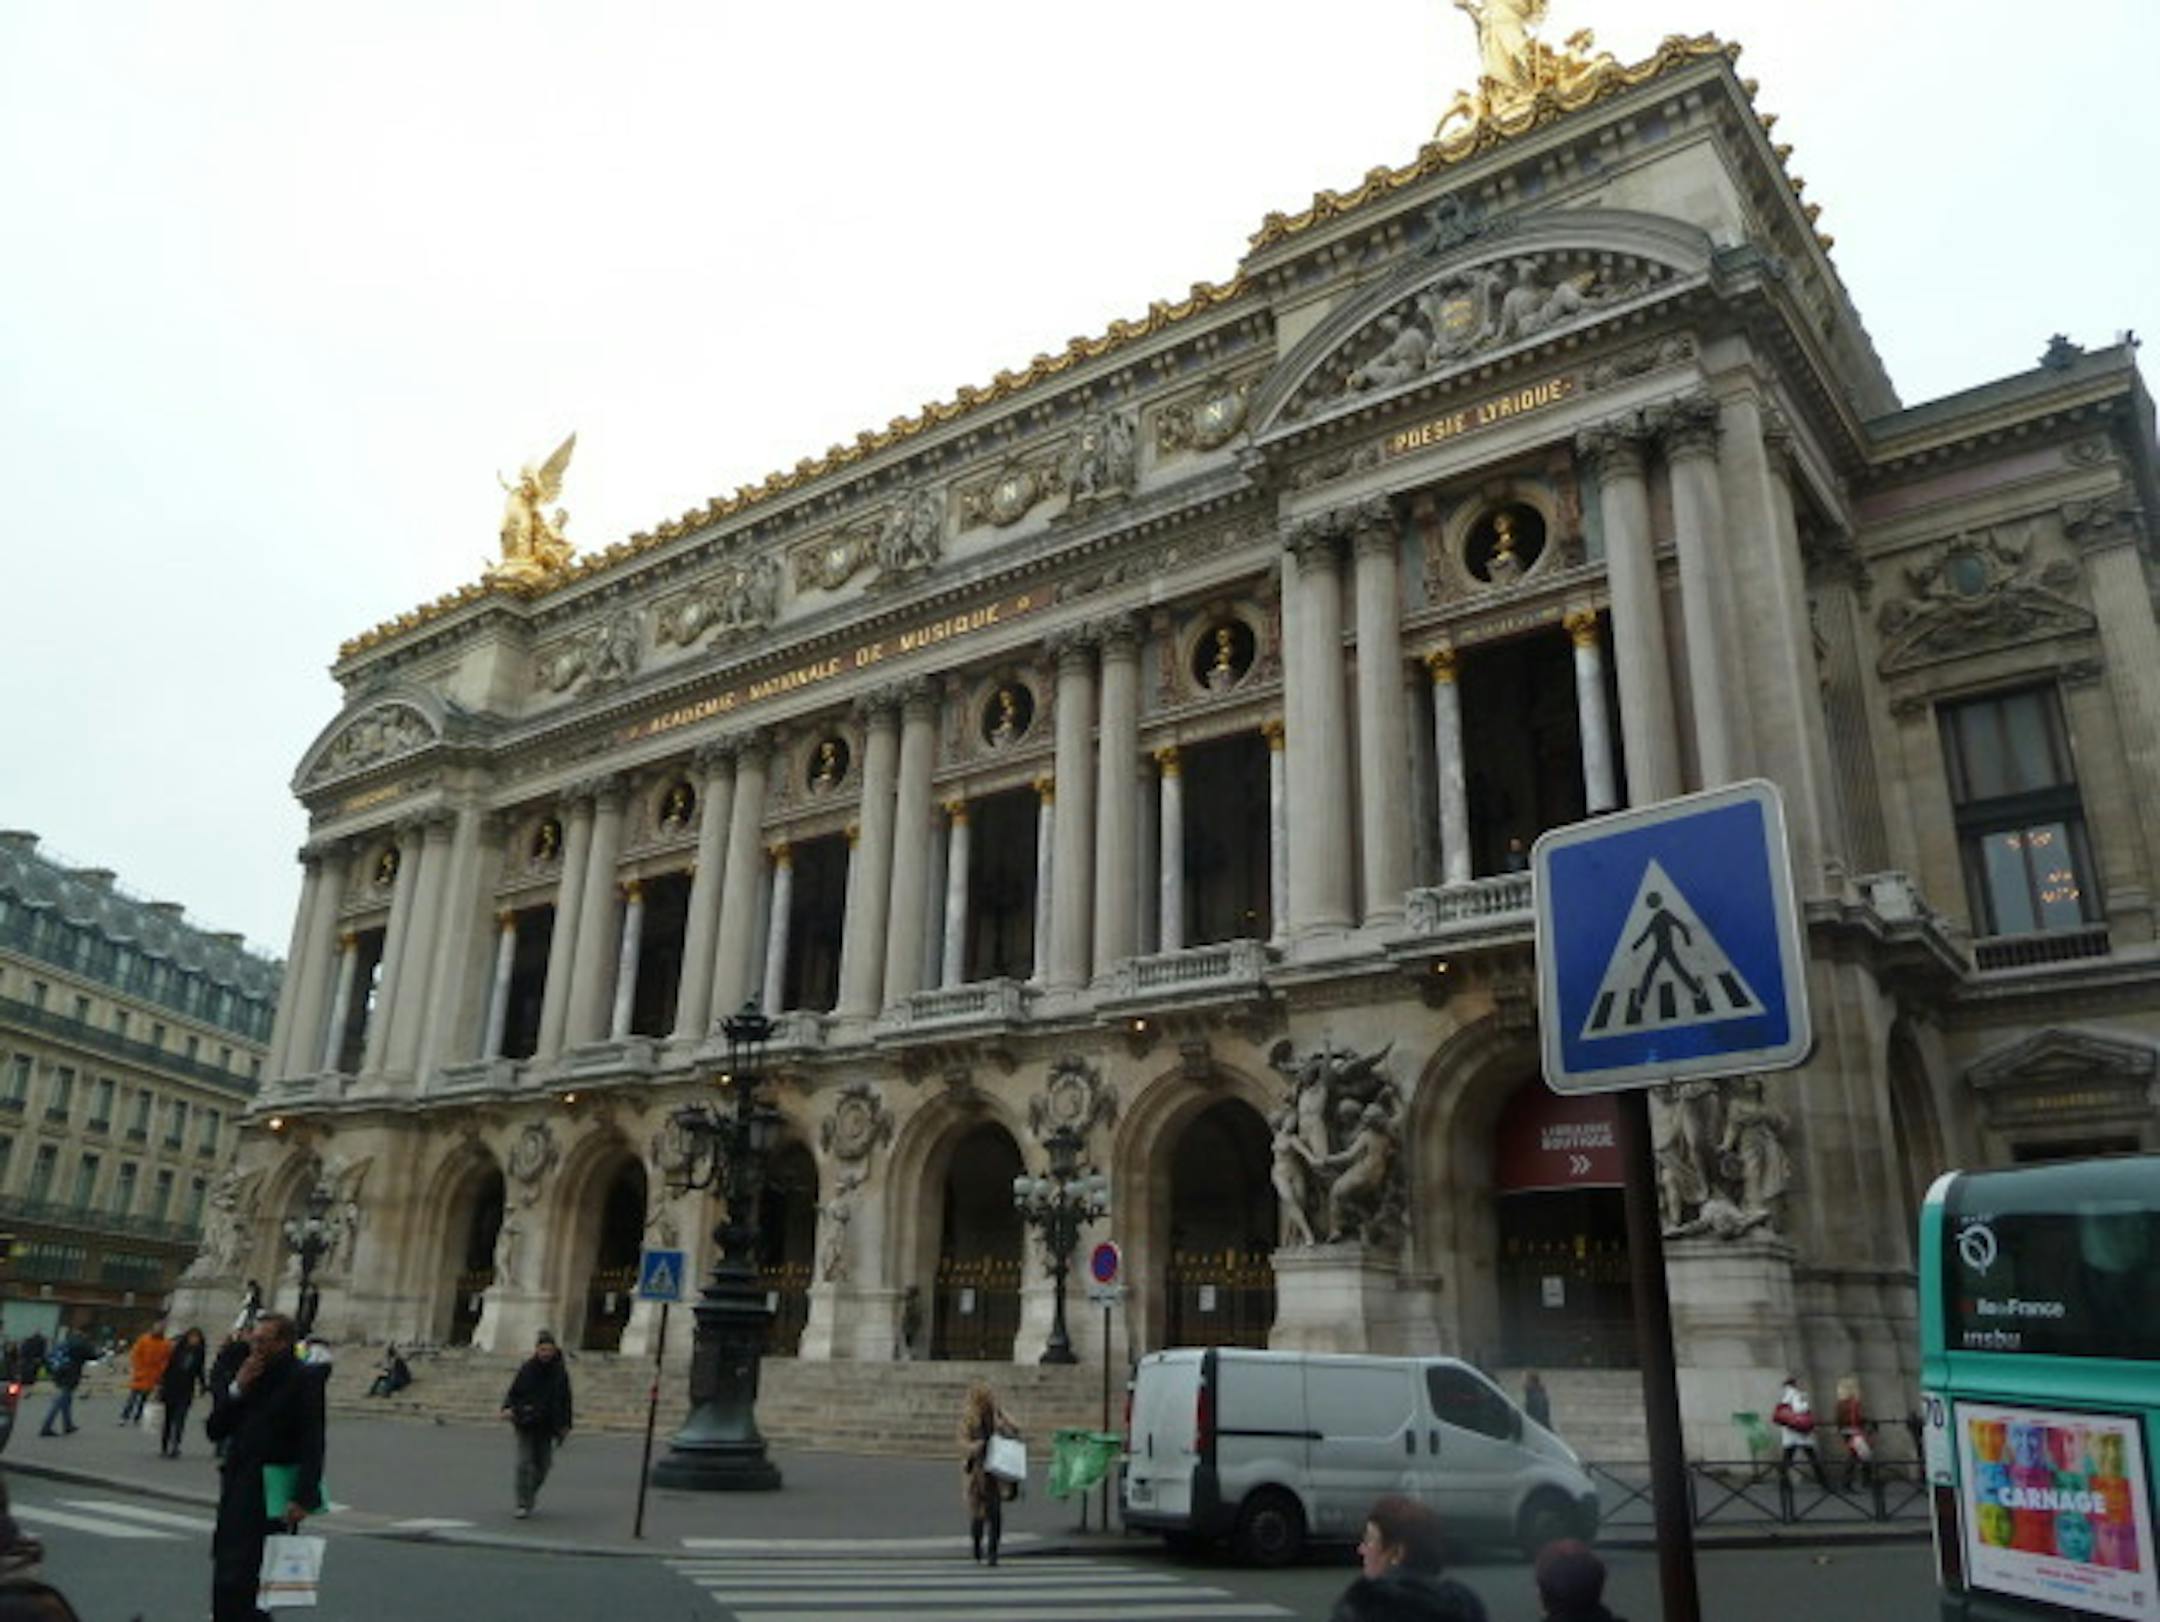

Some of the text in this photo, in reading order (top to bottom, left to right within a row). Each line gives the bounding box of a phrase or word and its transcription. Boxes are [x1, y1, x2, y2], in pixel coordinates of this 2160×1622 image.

[1477, 379, 1564, 425] LYRIQUE
[648, 602, 1000, 736] ACADEMIE NATIONALE DE MUSIQUE
[1997, 1486, 2108, 1515] CARNAGE
